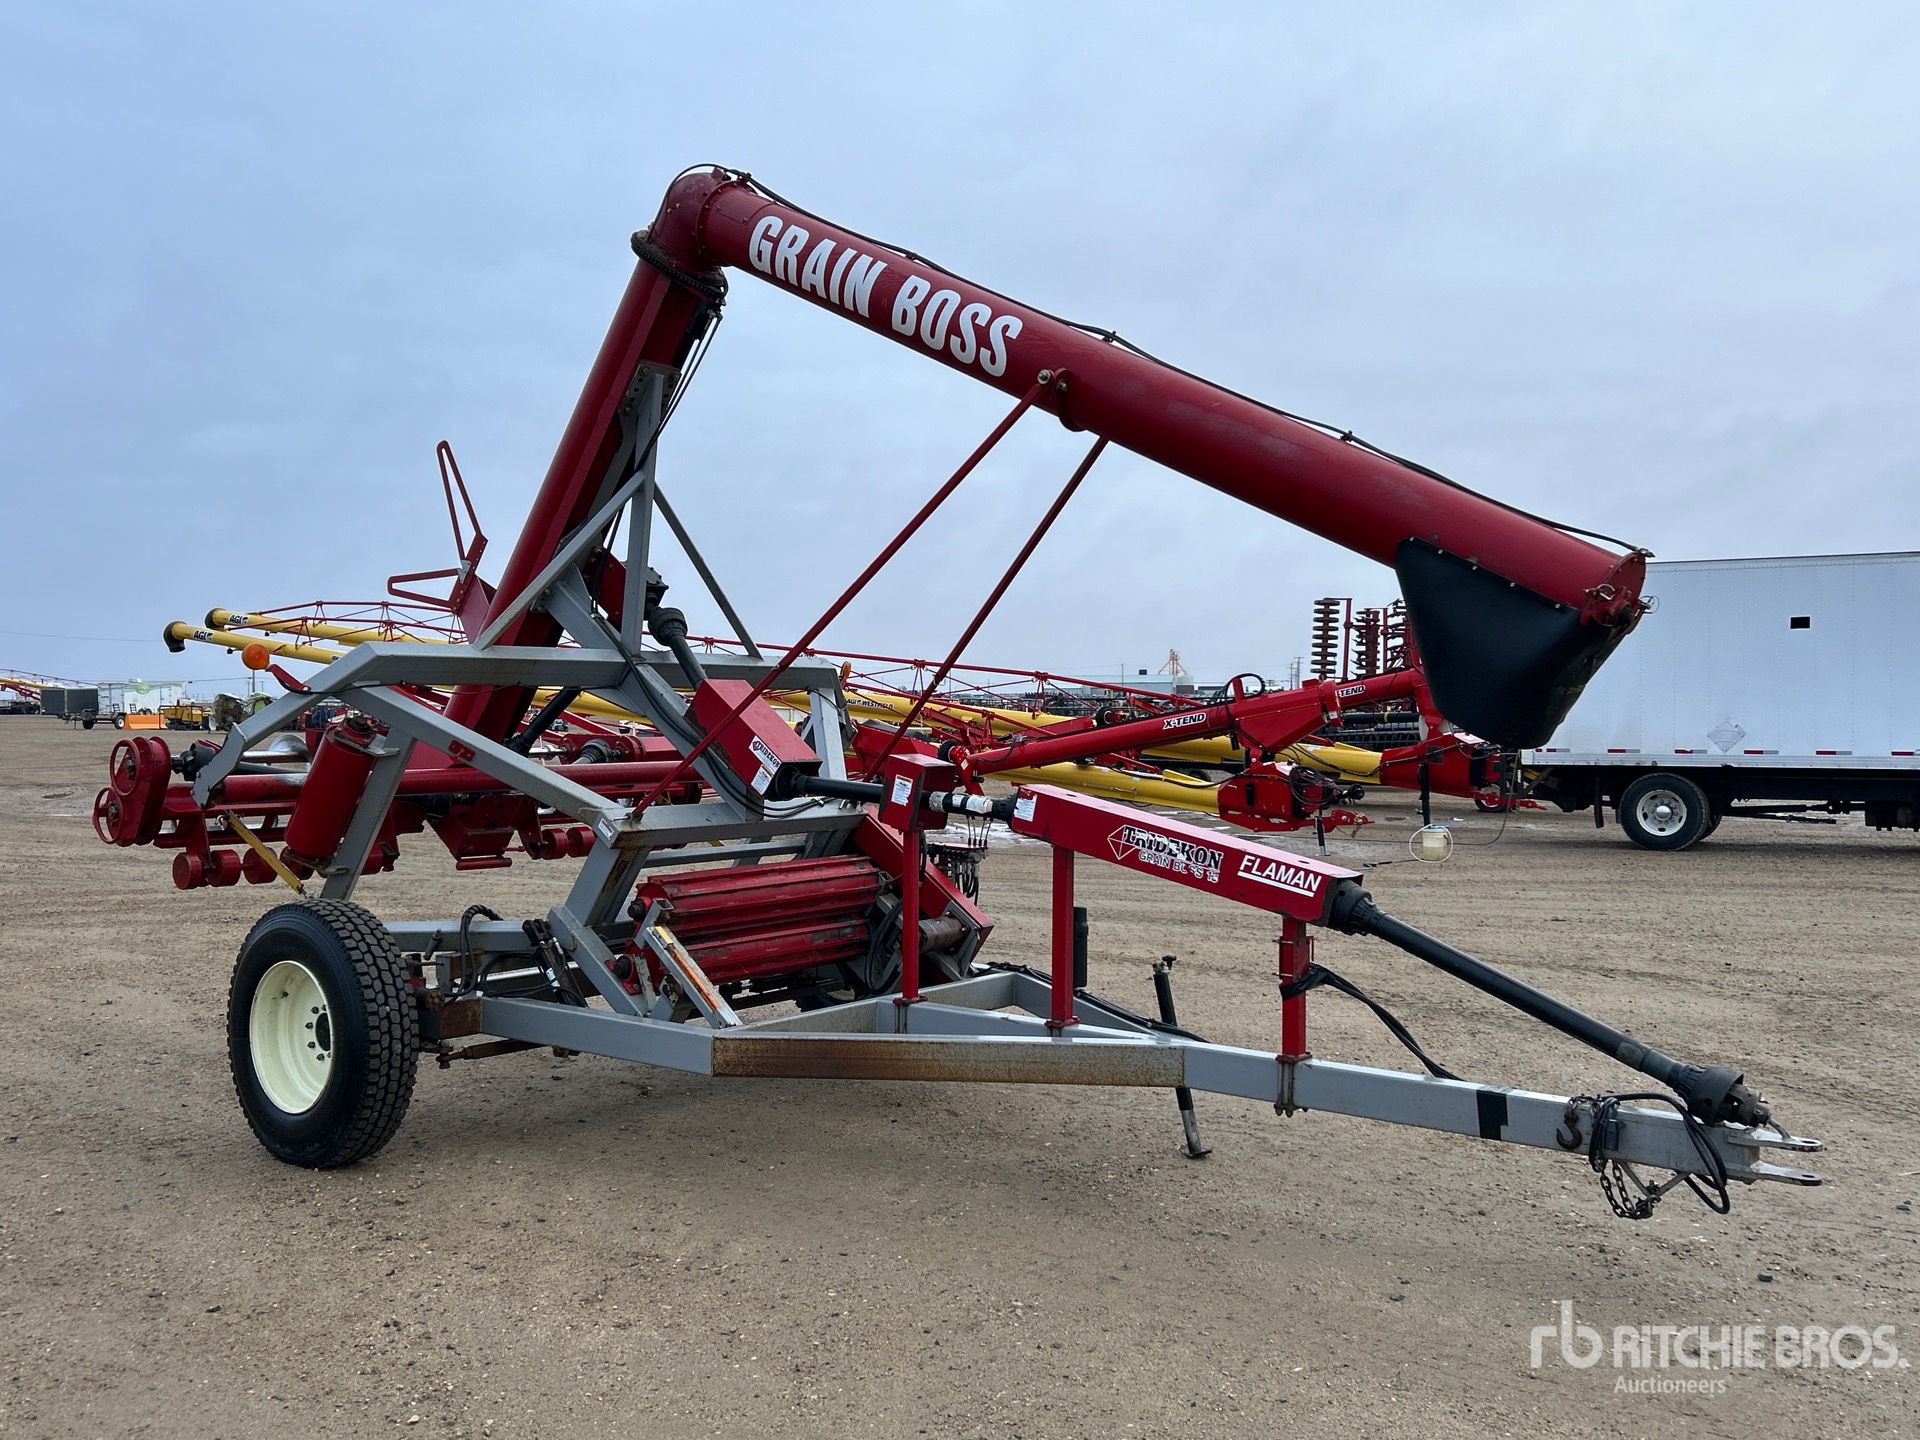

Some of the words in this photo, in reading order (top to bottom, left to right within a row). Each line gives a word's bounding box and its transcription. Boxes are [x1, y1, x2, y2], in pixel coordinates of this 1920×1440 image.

[749, 216, 888, 318] GRAIN
[892, 274, 1023, 377] BOSS
[1164, 713, 1206, 729] X-TEND
[755, 740, 781, 768] TRIDEKON
[1124, 825, 1223, 870] TRIDEKON
[1139, 850, 1171, 869] GRAIN
[1239, 854, 1322, 892] FLAMAN
